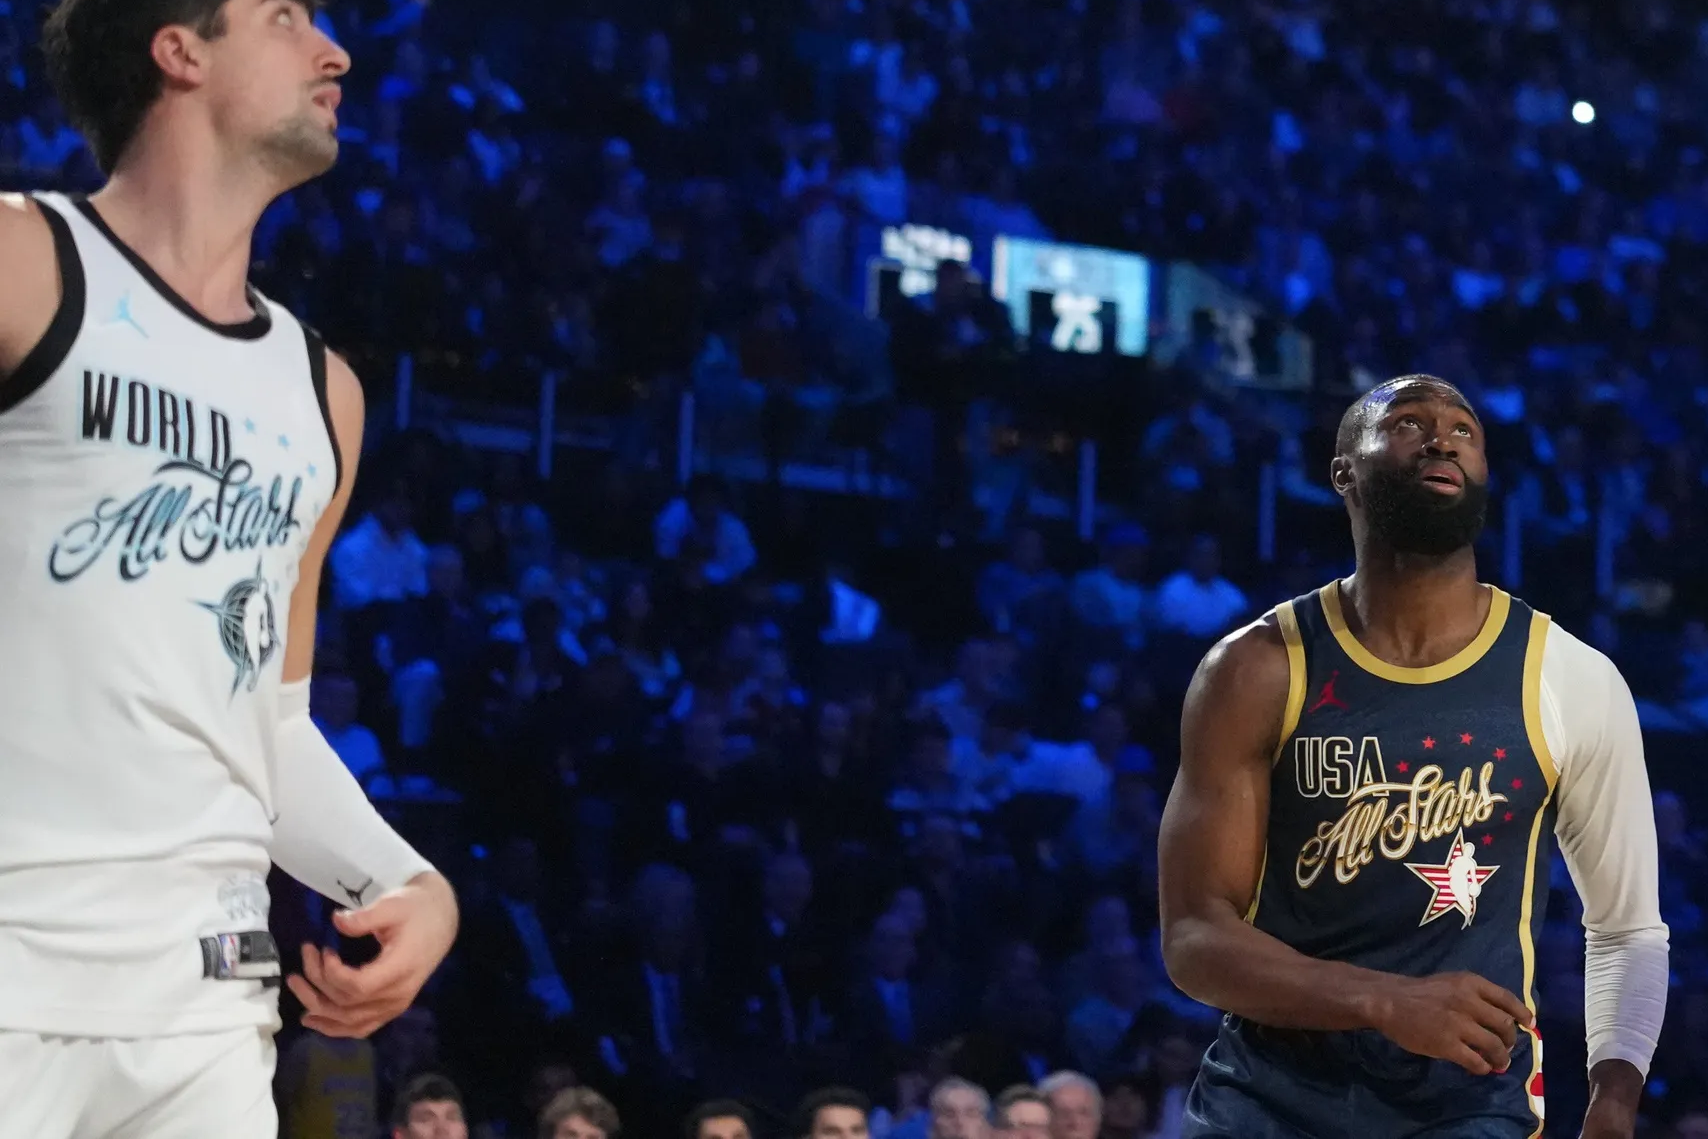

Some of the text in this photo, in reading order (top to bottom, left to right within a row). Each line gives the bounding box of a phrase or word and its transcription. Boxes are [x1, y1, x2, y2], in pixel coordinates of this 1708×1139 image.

[81, 370, 231, 475] WORLD
[49, 459, 300, 582] All Stars
[1295, 736, 1390, 799] USA
[1296, 761, 1509, 889] All Stars
